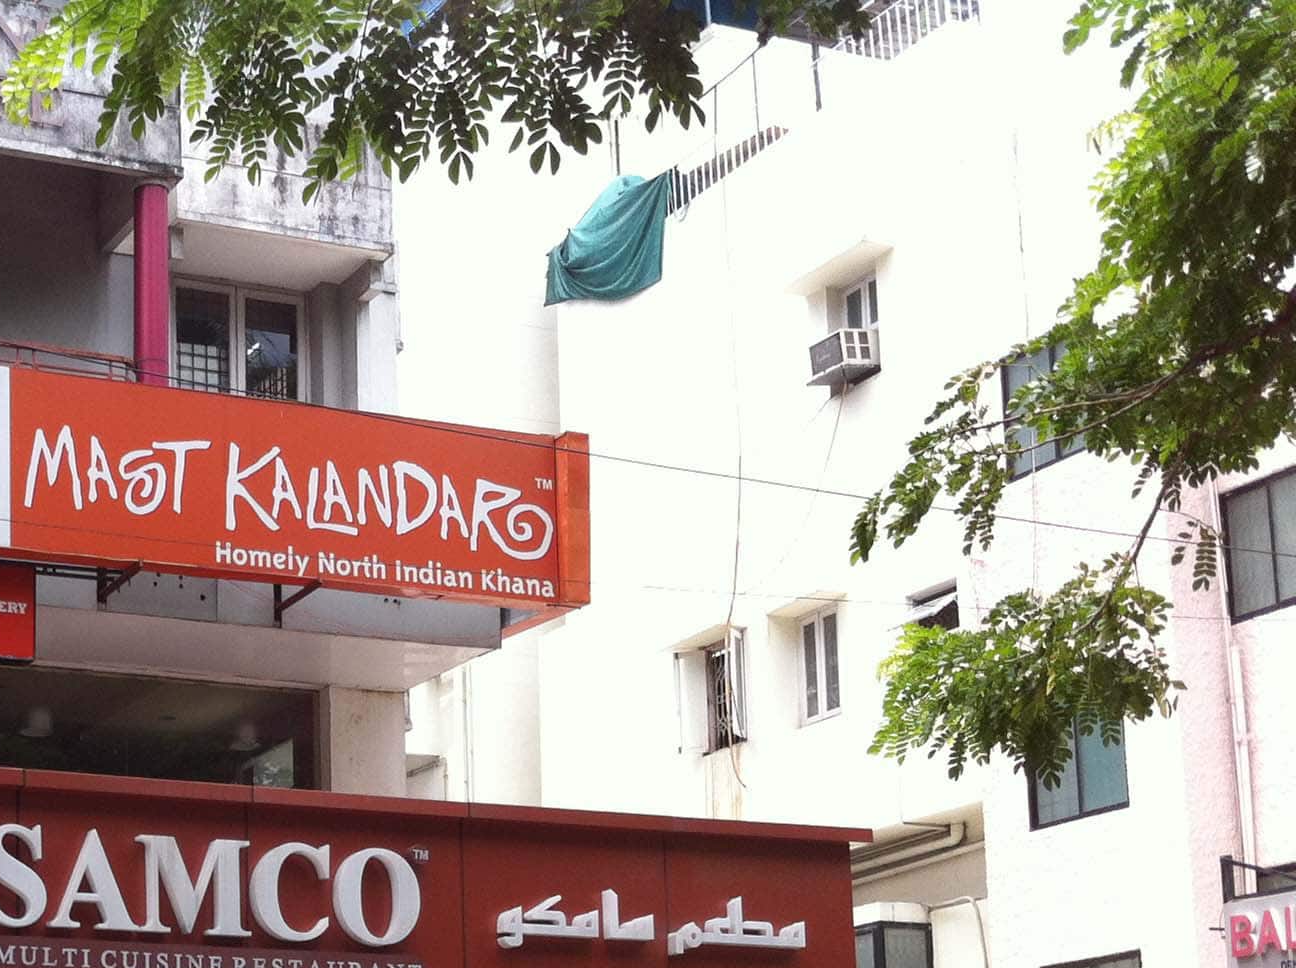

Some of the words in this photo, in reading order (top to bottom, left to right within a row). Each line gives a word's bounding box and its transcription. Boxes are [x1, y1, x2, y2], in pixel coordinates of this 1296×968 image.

[24, 425, 211, 515] MAST
[224, 441, 554, 561] KALANDAR
[215, 540, 310, 576] Homely
[318, 551, 387, 580] North
[395, 560, 473, 589] Indian
[481, 568, 555, 598] Khana
